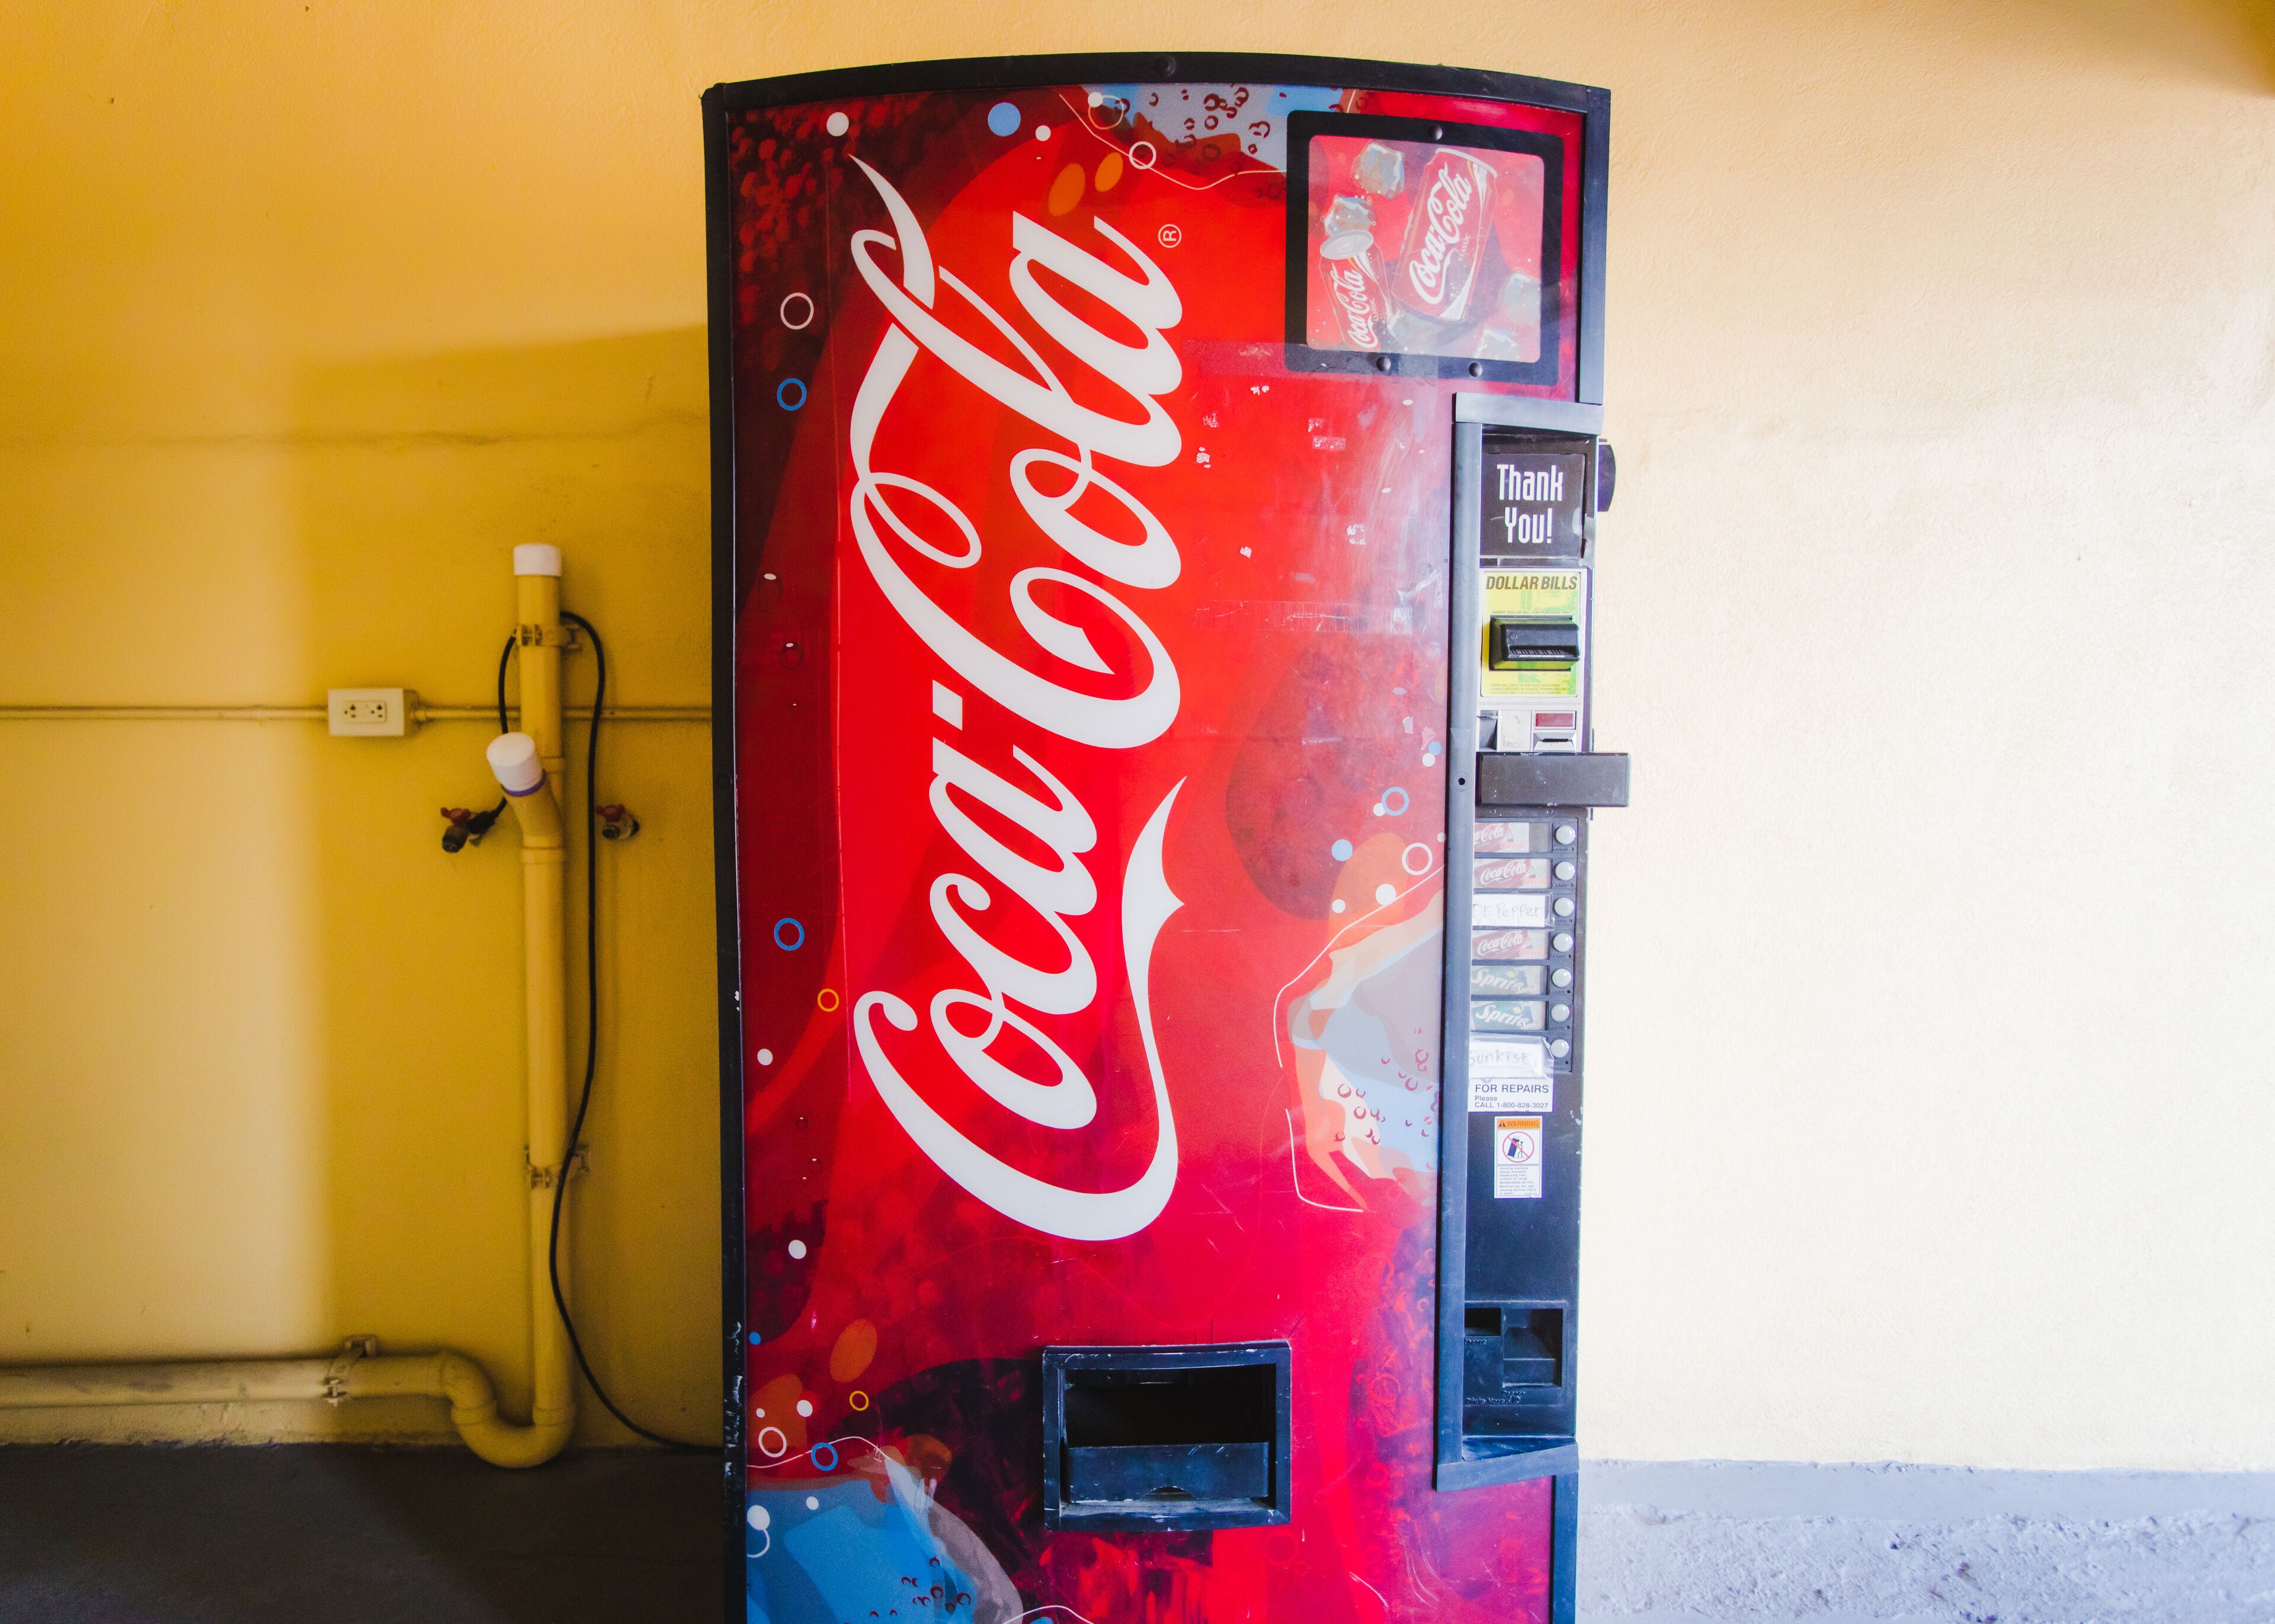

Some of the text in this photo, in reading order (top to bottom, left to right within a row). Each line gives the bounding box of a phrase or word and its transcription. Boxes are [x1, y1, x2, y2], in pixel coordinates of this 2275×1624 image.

[1409, 162, 1472, 305] Coca-Cola
[1457, 233, 1470, 261] CLASSIC
[1329, 262, 1378, 348] Coca-Cola
[1369, 297, 1379, 321] CLASSIC
[1497, 464, 1564, 501] Thank
[1504, 507, 1553, 544] You!
[1486, 576, 1578, 590] DOLLAR BILLS
[849, 153, 1186, 1241] Coca-Cola
[1480, 861, 1527, 885] Coca-Cola
[1497, 902, 1540, 920] Pepper
[1478, 931, 1524, 956] Coca-Cola
[1470, 969, 1524, 991] Sprite
[1475, 1004, 1530, 1027] Sprite
[1469, 1049, 1527, 1066] Sunkist
[1475, 1084, 1549, 1093] FOR REPAIRS
